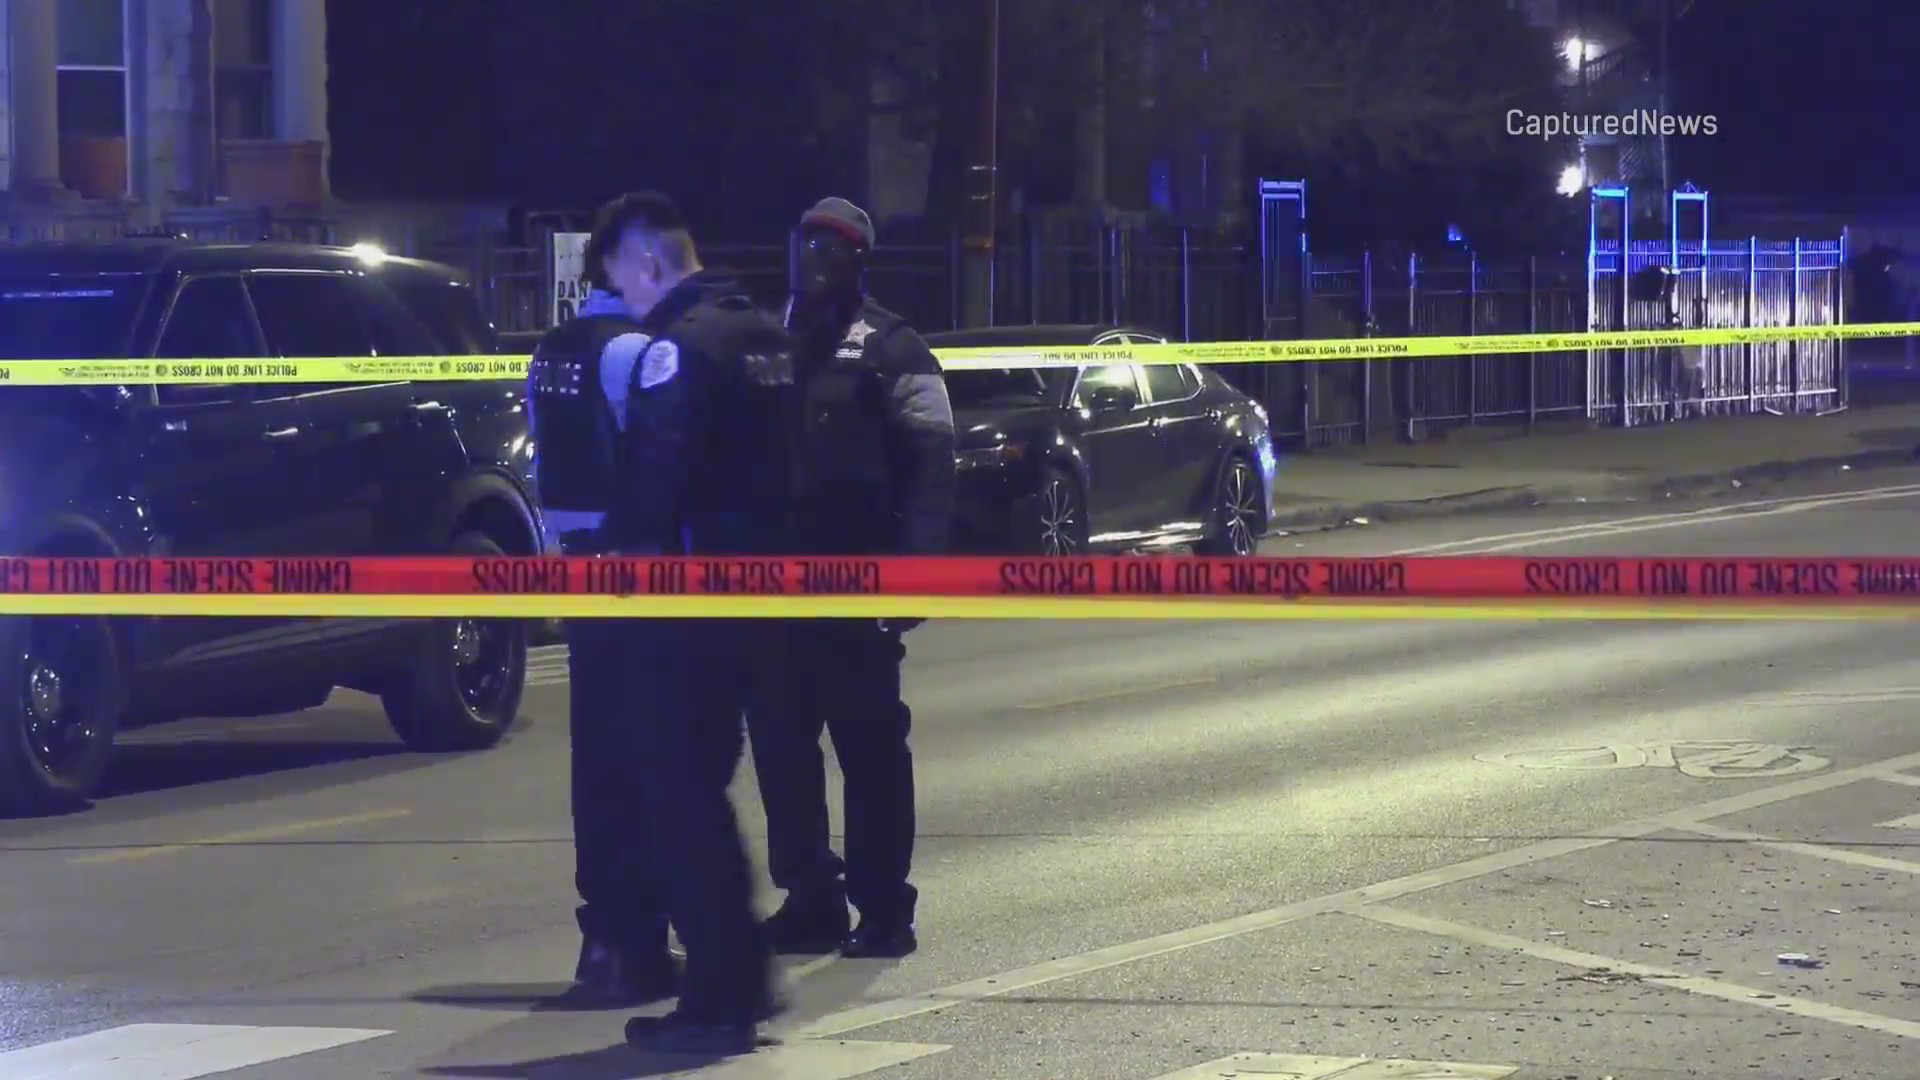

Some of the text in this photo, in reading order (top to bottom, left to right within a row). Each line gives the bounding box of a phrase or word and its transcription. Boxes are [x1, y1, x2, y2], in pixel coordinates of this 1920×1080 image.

[1286, 344, 1409, 355] POLICE LINE DO NOT CROSS
[171, 364, 298, 378] POLICE LINE DO NOT CROSS
[455, 361, 485, 374] CROSS
[488, 360, 506, 374] NOT
[508, 360, 523, 373] DO
[48, 559, 99, 592] NOT
[113, 559, 151, 592] DO
[161, 559, 254, 592] SCENE
[264, 559, 351, 592] CRIME
[472, 560, 880, 593] CRIME SCENE DO NOT CROSS
[1000, 561, 1405, 594] CRIME SCENE DO NOT CROSS
[1525, 561, 1620, 594] CROSS
[1701, 561, 1739, 594] DO
[1749, 561, 1838, 594] SCENE
[1849, 561, 1920, 594] RIME
